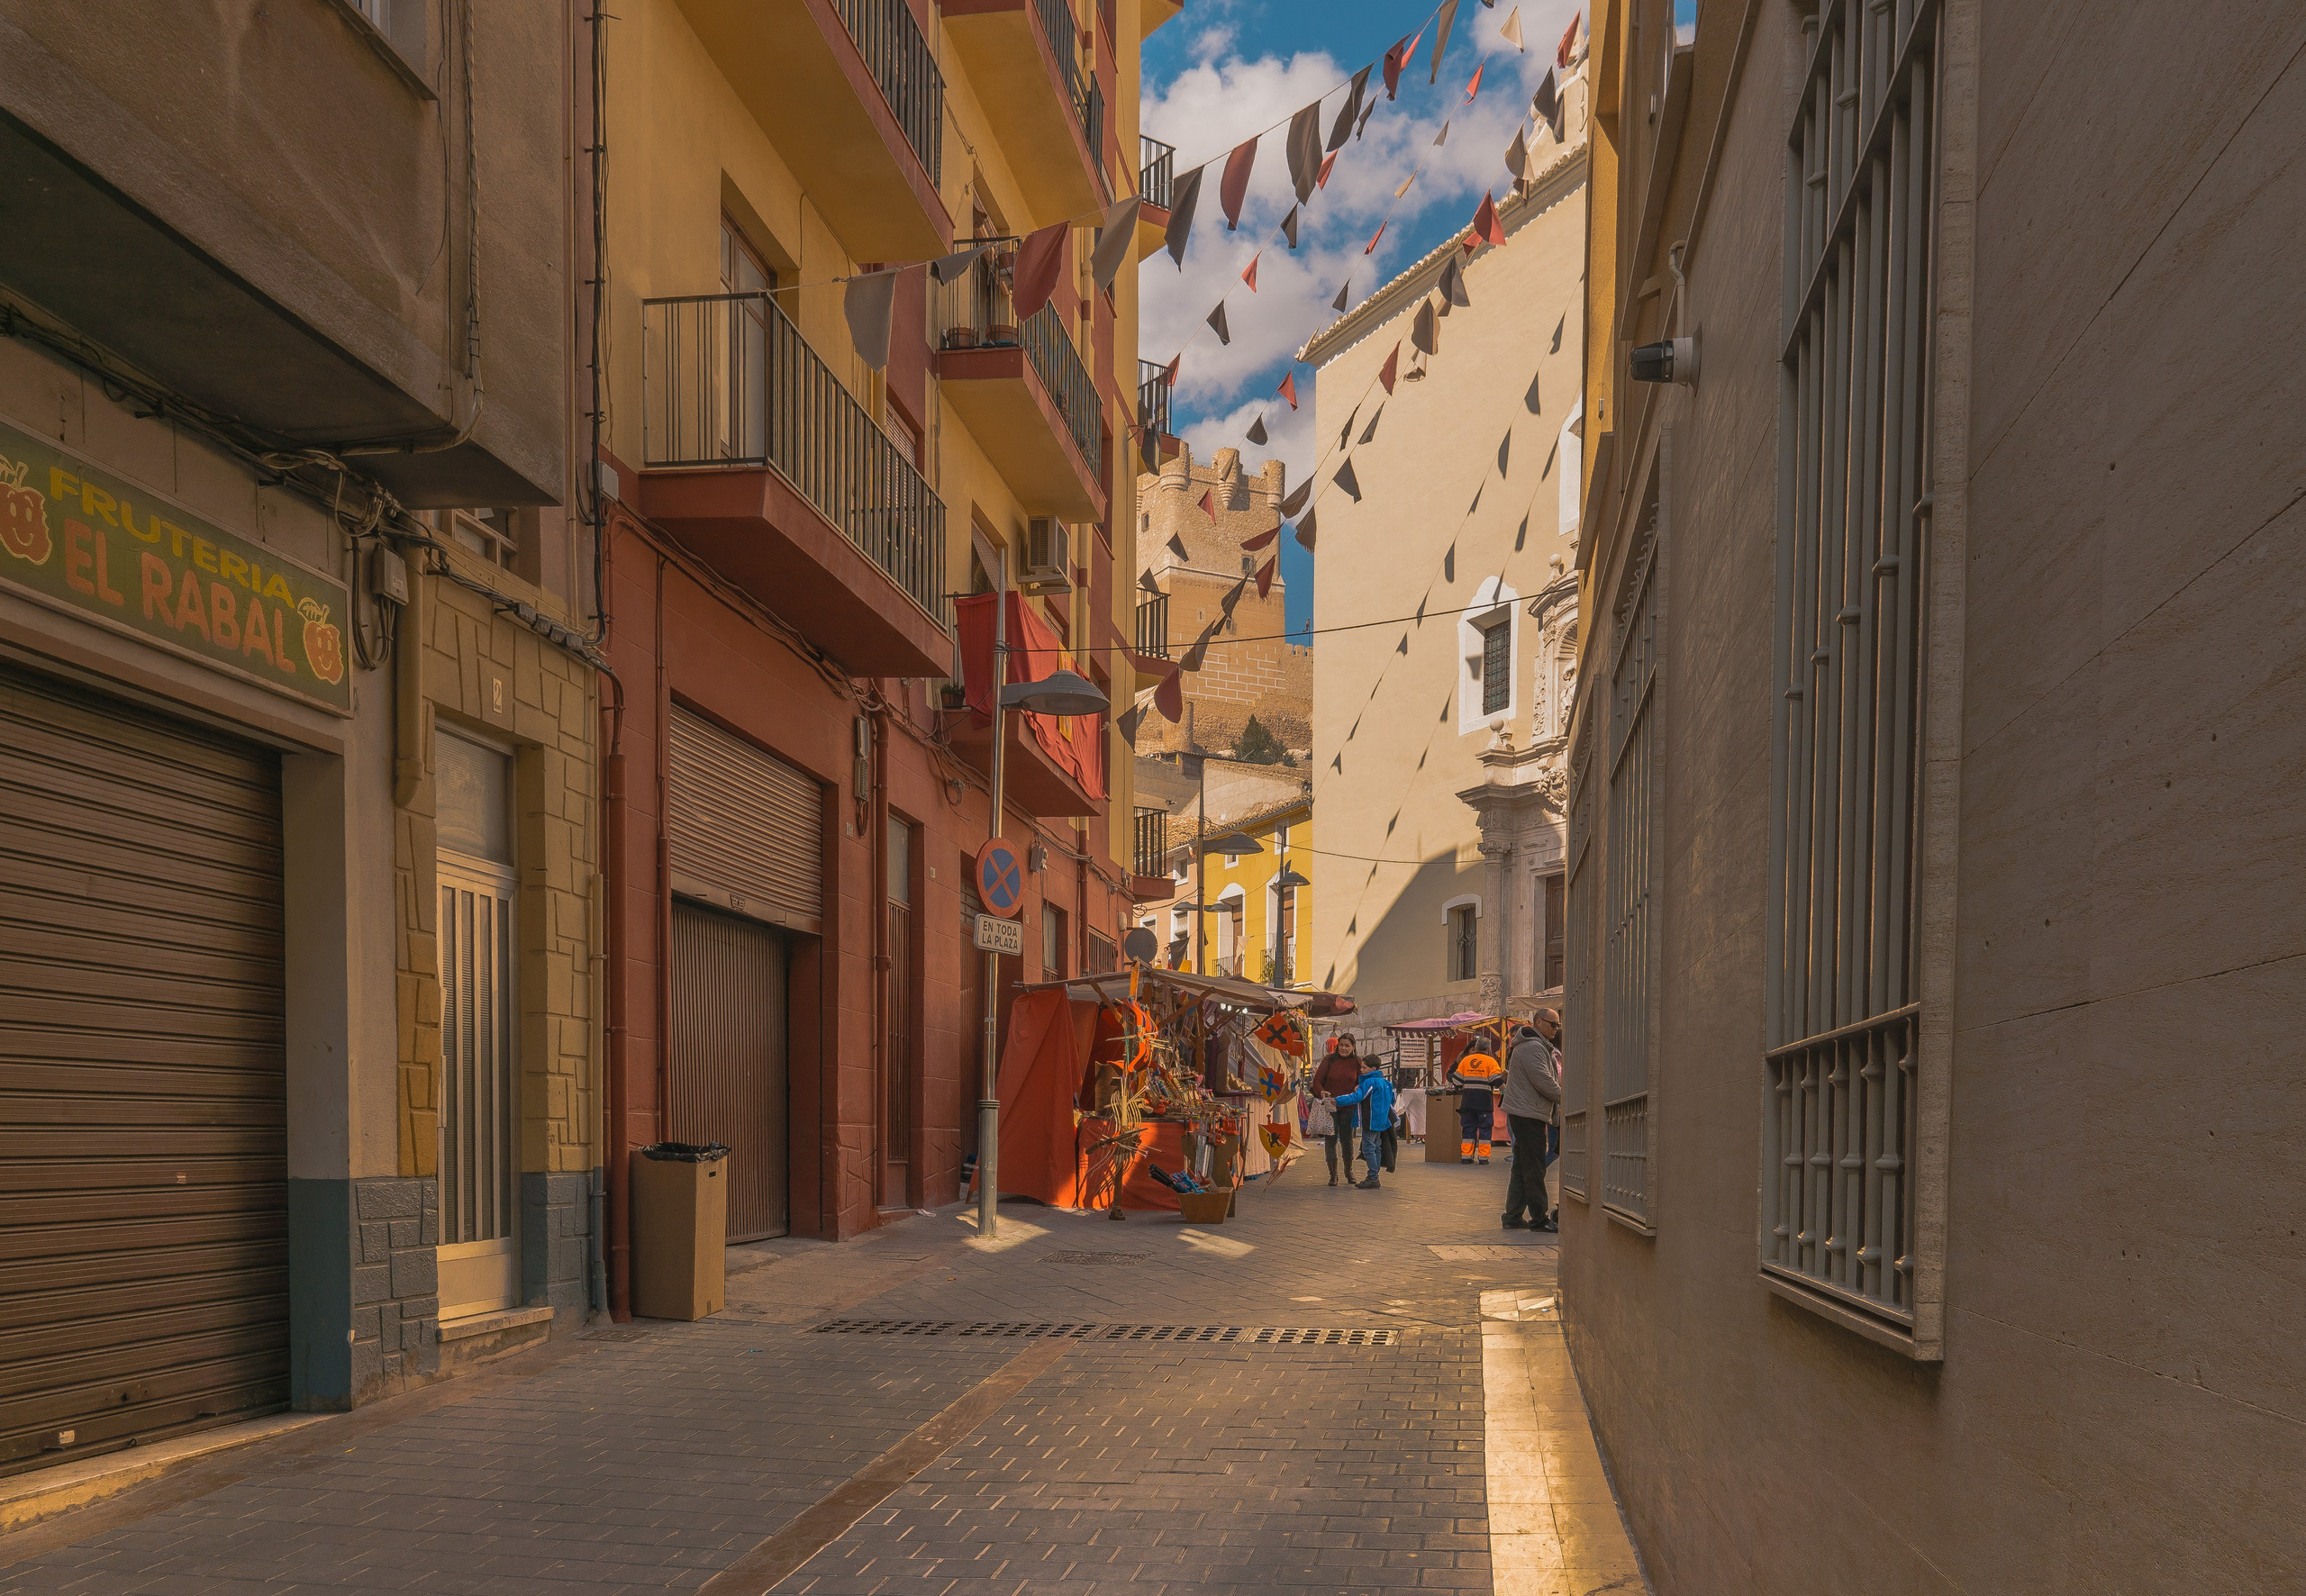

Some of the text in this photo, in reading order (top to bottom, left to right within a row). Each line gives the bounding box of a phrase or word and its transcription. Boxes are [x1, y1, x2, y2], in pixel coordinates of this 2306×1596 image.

[50, 466, 295, 609] FRUTERIA
[64, 518, 296, 674] EL RABAL
[495, 683, 501, 711] 2
[982, 935, 1018, 950] LA PLAZA
[983, 920, 1018, 938] EN TODA
